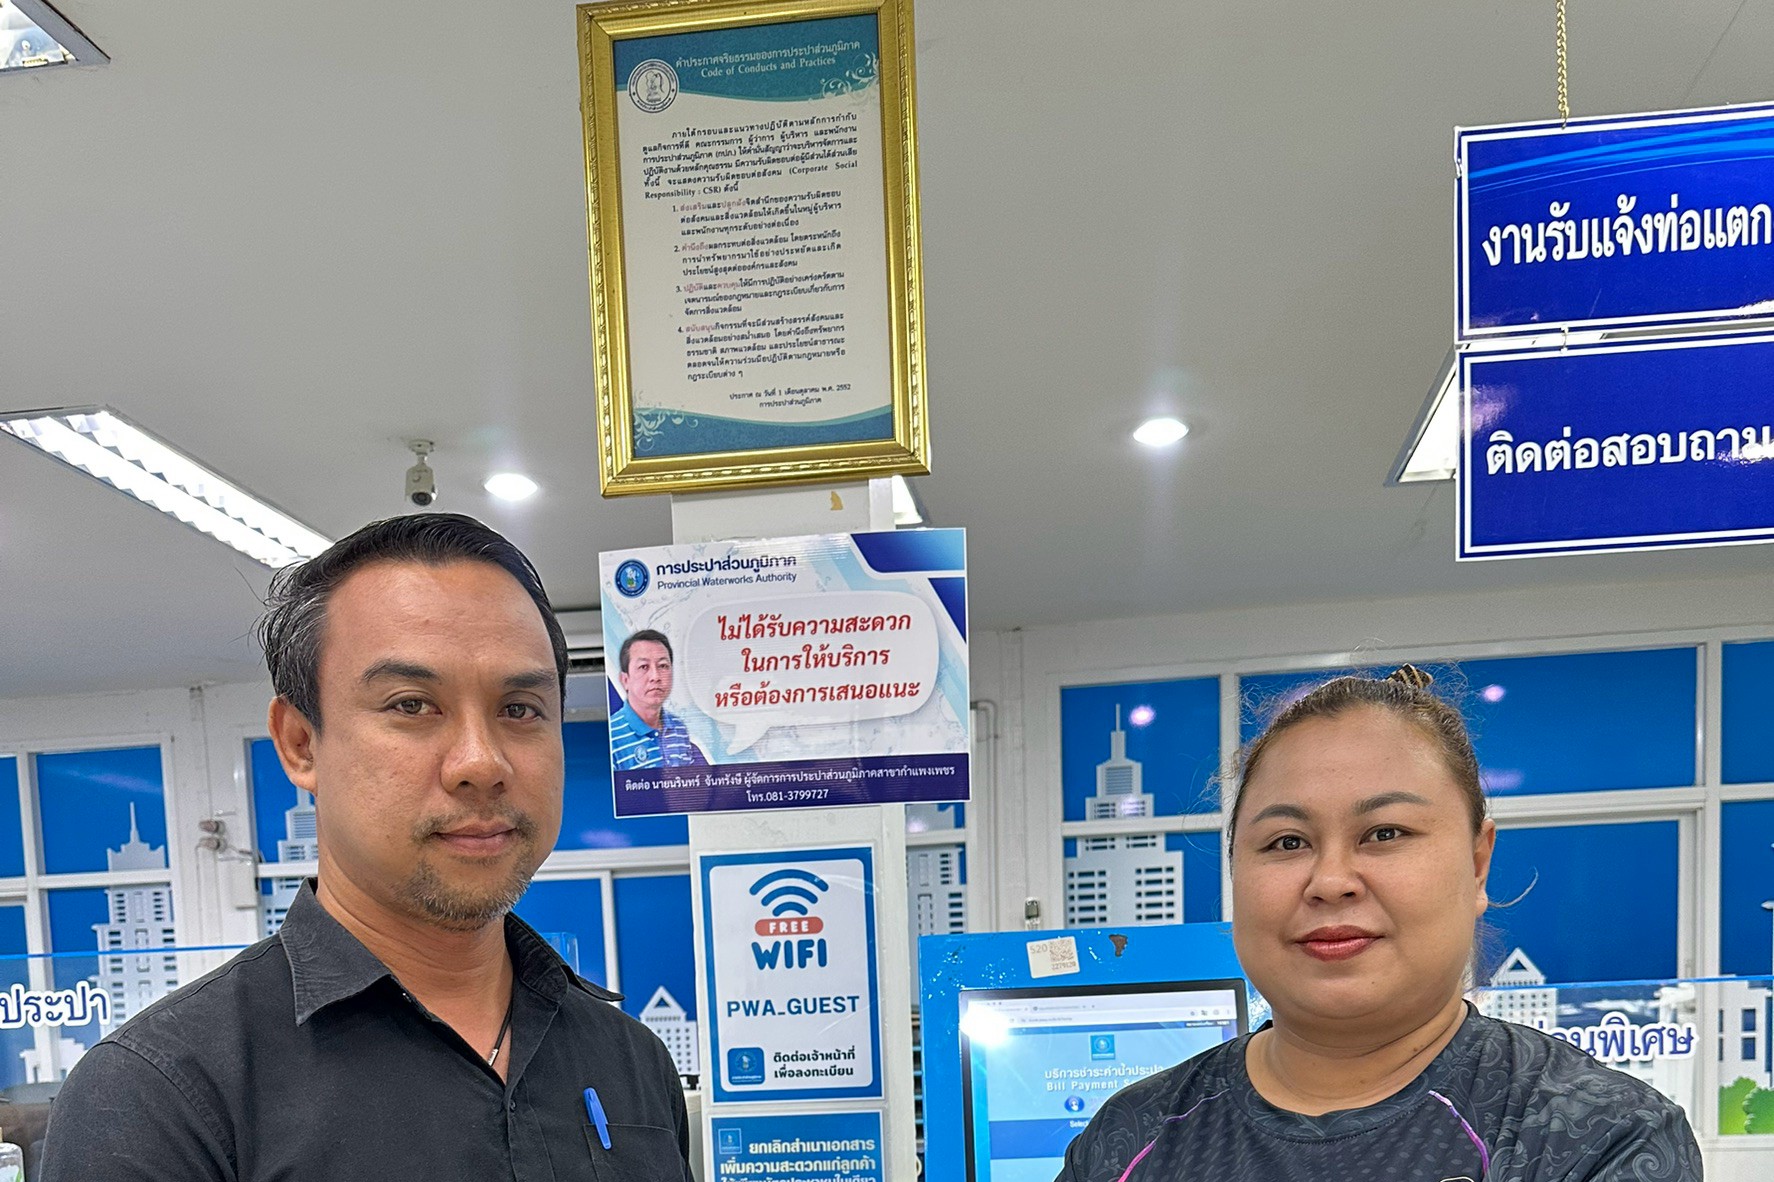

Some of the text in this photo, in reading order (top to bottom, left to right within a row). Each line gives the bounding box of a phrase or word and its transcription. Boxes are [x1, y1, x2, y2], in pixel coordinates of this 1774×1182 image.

[701, 55, 836, 78] Code of Conducts and Practices
[835, 160, 858, 170] Social
[645, 188, 696, 200] Responsibility
[1482, 193, 1772, 266] งานรับแจ้งท่อแตก
[656, 555, 797, 576] การประปาส่วนภูมิภาค
[657, 573, 797, 590] Provincial Waterworks Authority
[718, 612, 911, 641] ไม่ได้รับความสะดวก
[741, 645, 890, 673] ในการให้บริการ
[715, 680, 921, 708] หรือต้องการเสนอแนะ
[625, 778, 651, 791] ติดต่อ
[652, 774, 700, 789] นายนรินทร์
[744, 765, 955, 787] ผู้จัดการการประปาส่วนภูมิภาคสาขากำแพงเพชร
[746, 789, 829, 803] โทร.081-3799727
[768, 920, 810, 935] FREE
[751, 938, 828, 970] WIFI
[727, 995, 860, 1018] PWA_GUEST
[774, 1045, 856, 1063] ติดต่อเจ้าหน้าที่
[774, 1063, 854, 1078] เพื่อลงทะเบียน
[1046, 1082, 1065, 1091] Bill
[1071, 1080, 1118, 1092] Payment
[749, 1138, 875, 1155] ยกเลิกสำเนาเอกสาร
[720, 1155, 876, 1175] เพิ่มความสะดวกแก่ลูกค้า
